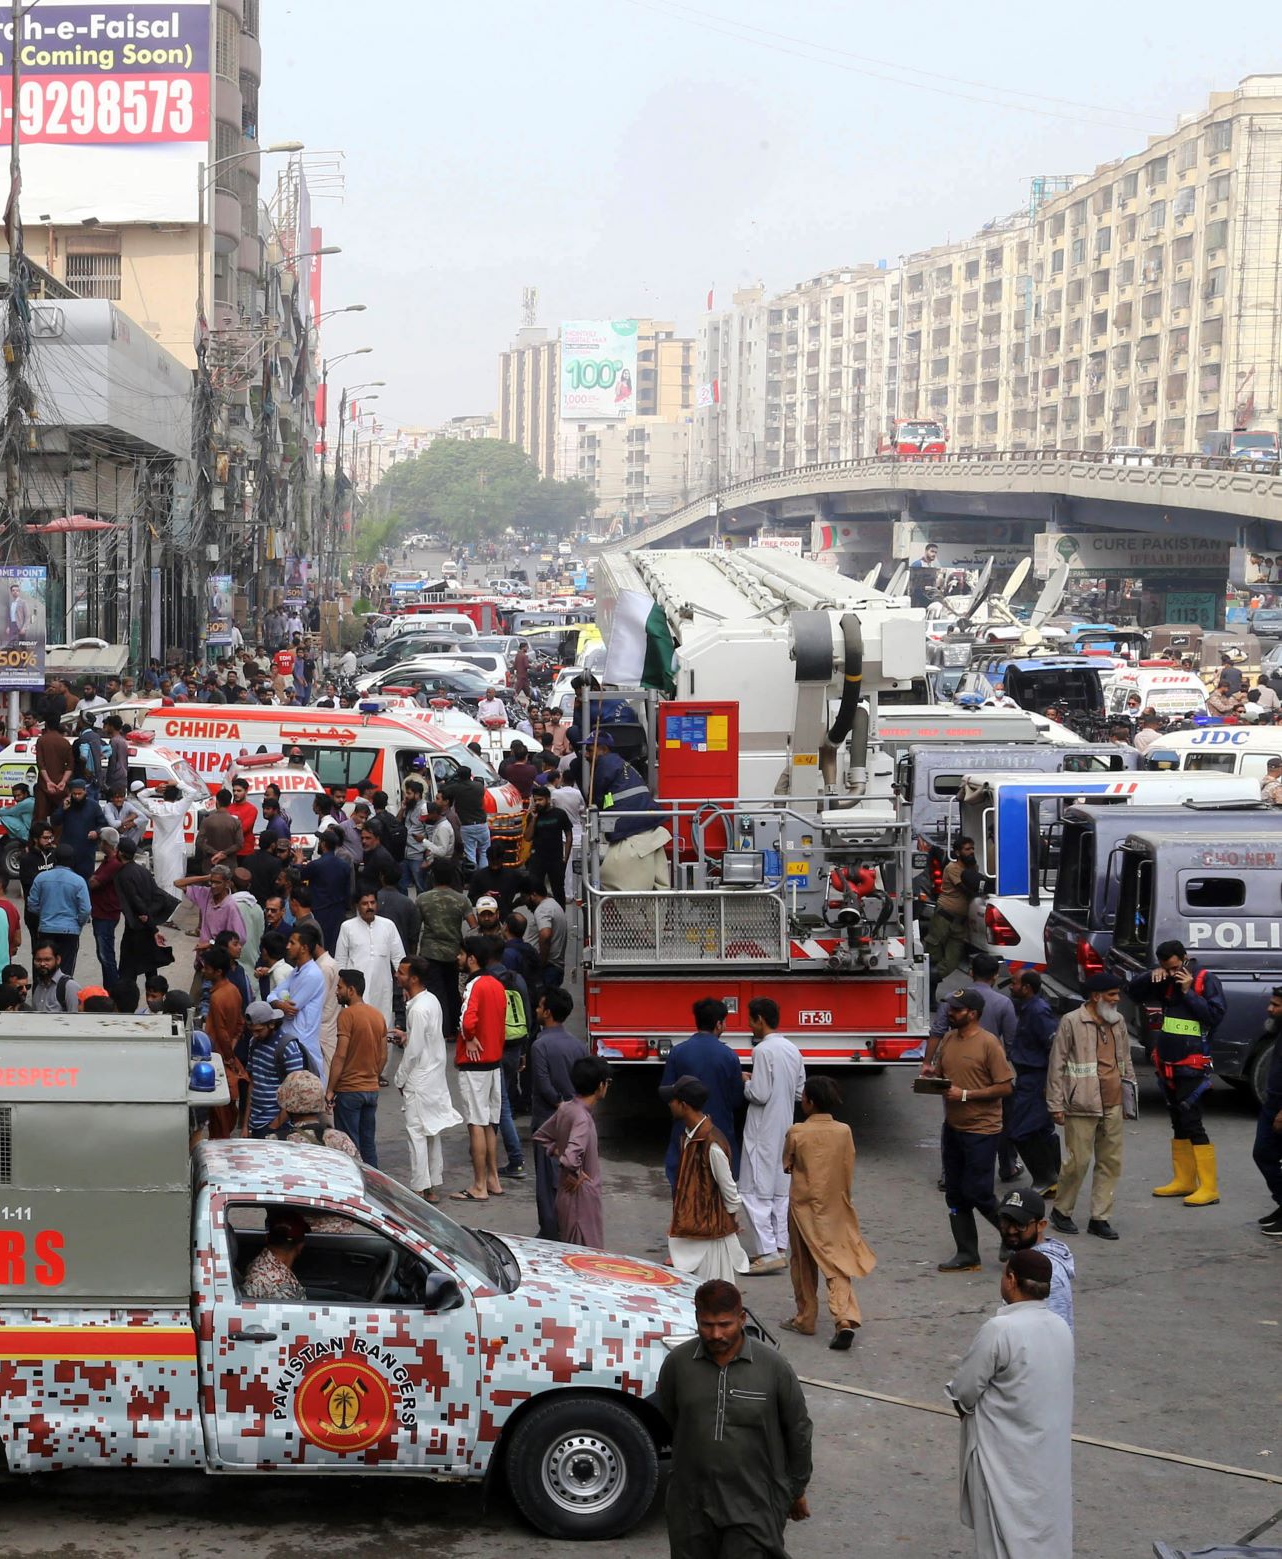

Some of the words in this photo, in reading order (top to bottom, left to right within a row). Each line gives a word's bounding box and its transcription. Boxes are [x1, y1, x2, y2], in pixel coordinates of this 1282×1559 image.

[122, 43, 193, 69] Soon)
[761, 540, 778, 548] FREE
[779, 540, 800, 548] FOOD
[1093, 538, 1137, 550] CURE
[1142, 538, 1221, 550] PAKISTAN
[16, 568, 45, 577] POINT
[165, 720, 241, 739] CHHIPA
[1191, 730, 1250, 745] JDC
[800, 1012, 832, 1024] FT-30
[273, 1337, 345, 1421] PAKISTAN
[353, 1337, 417, 1426] RANGERS
